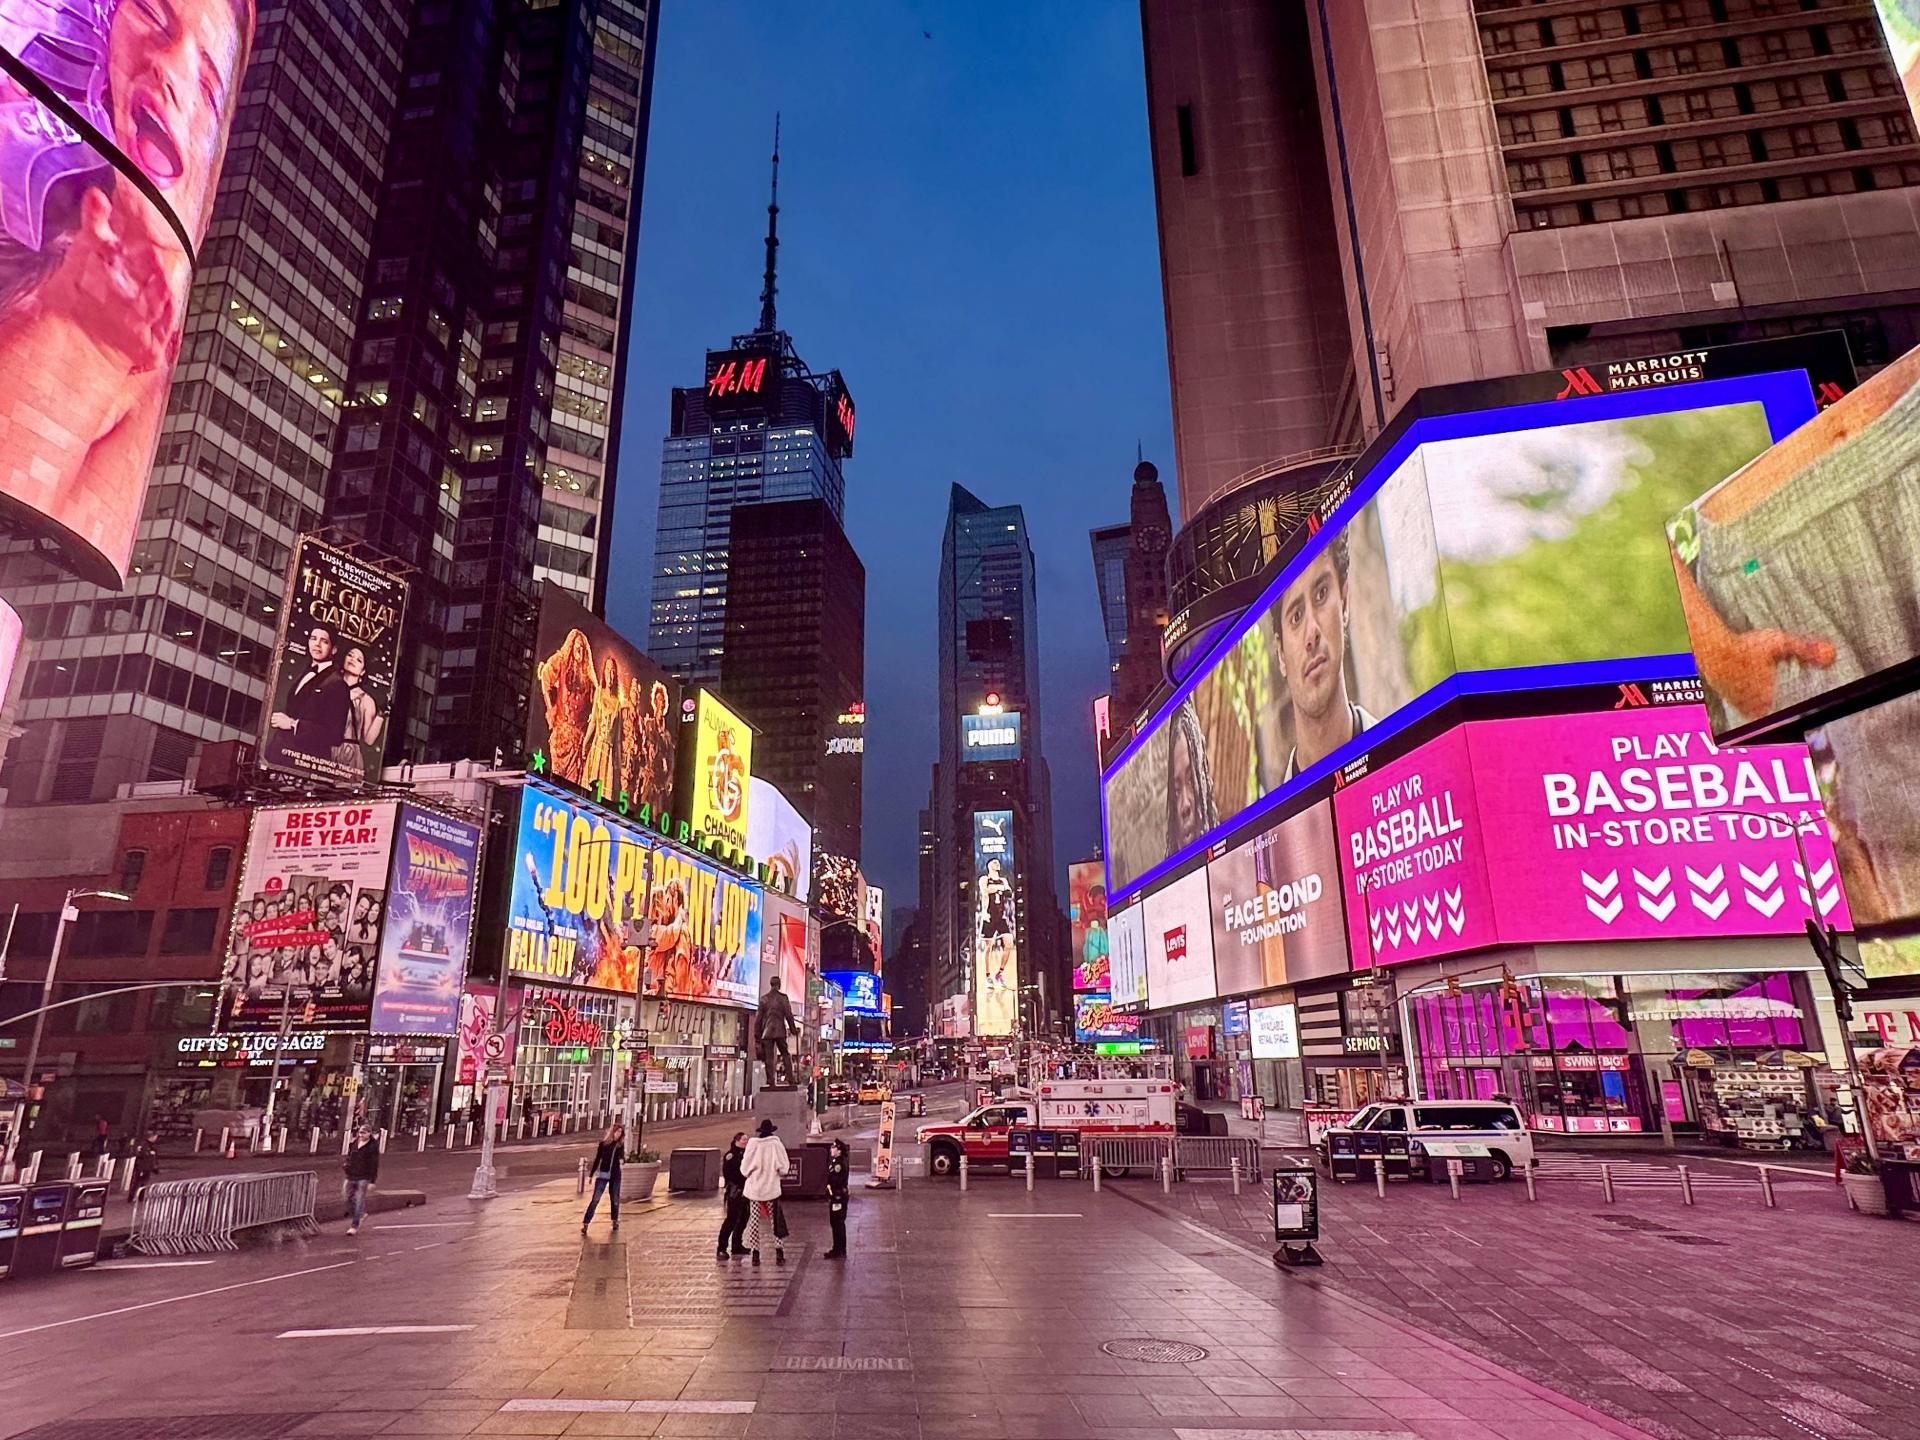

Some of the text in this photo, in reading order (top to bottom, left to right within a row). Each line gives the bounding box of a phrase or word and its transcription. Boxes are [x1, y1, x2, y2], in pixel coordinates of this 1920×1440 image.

[1608, 351, 1708, 375] MARRIOTT
[708, 358, 766, 397] H&M
[1611, 366, 1700, 389] MARQUIS
[837, 393, 854, 441] H&M
[1320, 470, 1354, 511] MARRIOTT
[1322, 488, 1351, 523] MARQUIS
[331, 566, 338, 574] &
[345, 563, 391, 590] BEWITCHING
[303, 570, 337, 603] THE
[339, 589, 395, 628] GREAT
[310, 600, 385, 644] GATSBY
[682, 713, 695, 724] LG
[967, 728, 1016, 747] PUMA
[1611, 731, 1691, 761] PLAY
[302, 751, 337, 768] BROADWAY
[317, 765, 353, 779] BROADWAY
[1371, 774, 1423, 817] PLAY VR
[286, 809, 373, 829] BEST OF
[406, 820, 430, 835] MUSICAL
[440, 822, 447, 831] TO
[1350, 790, 1463, 869] BASEBALL
[1552, 809, 1826, 850] IN-STORE TODA
[274, 828, 378, 848] THE YEAR!
[405, 832, 468, 873] BACK
[1356, 836, 1464, 895] IN-STORE TODAY
[1224, 895, 1266, 932] FACE
[1266, 873, 1322, 916] BOND
[1240, 910, 1307, 946] FOUNDATION
[509, 928, 576, 978] FALL GUY
[178, 1036, 229, 1051] GIFTS
[247, 1050, 263, 1059] NY
[1602, 1056, 1624, 1067] BIG!
[1056, 1103, 1130, 1115] F.D. N.Y.
[785, 1356, 909, 1371] BEAUMONT
